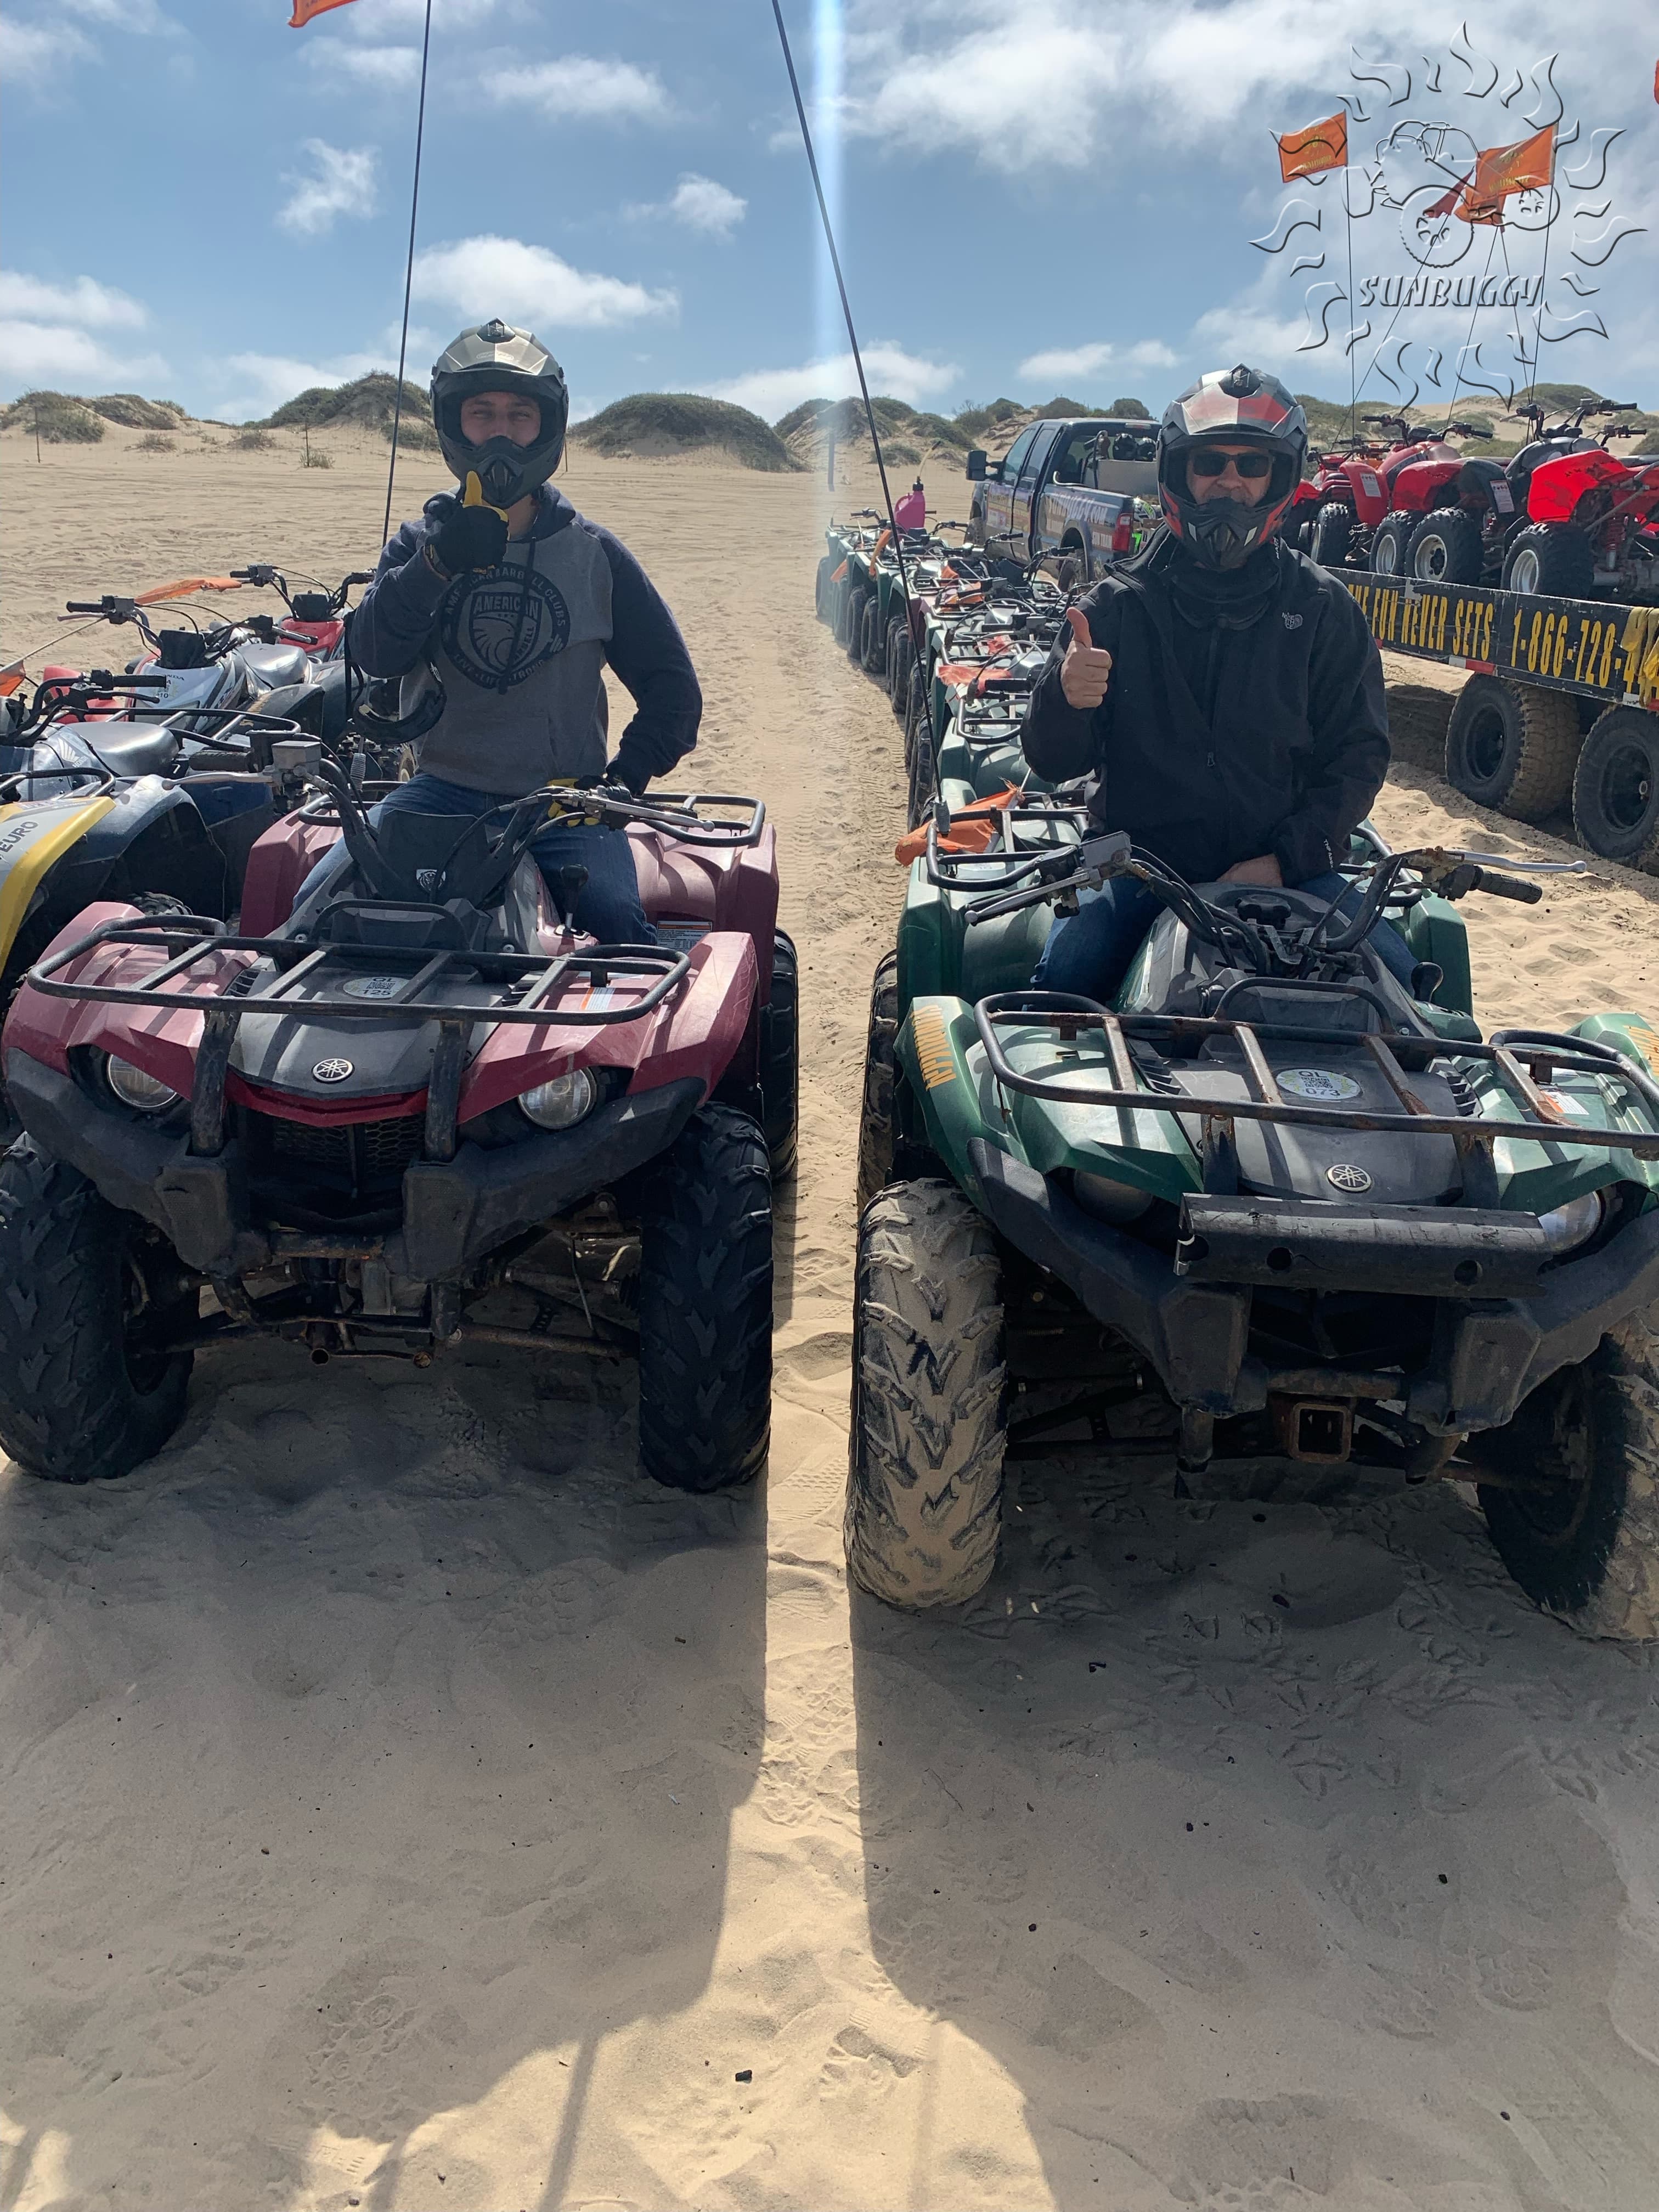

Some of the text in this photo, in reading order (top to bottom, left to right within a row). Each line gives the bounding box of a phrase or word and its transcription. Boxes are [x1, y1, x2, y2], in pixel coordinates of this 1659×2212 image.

[473, 595, 539, 620] AMERICN
[495, 567, 543, 590] BARBLL
[544, 588, 566, 627] CLUBS
[1372, 588, 1398, 641] FUN
[1401, 594, 1448, 651] NEVER
[1453, 599, 1493, 661] SETS
[0, 821, 38, 853] EURO
[1305, 1087, 1340, 1096] 073
